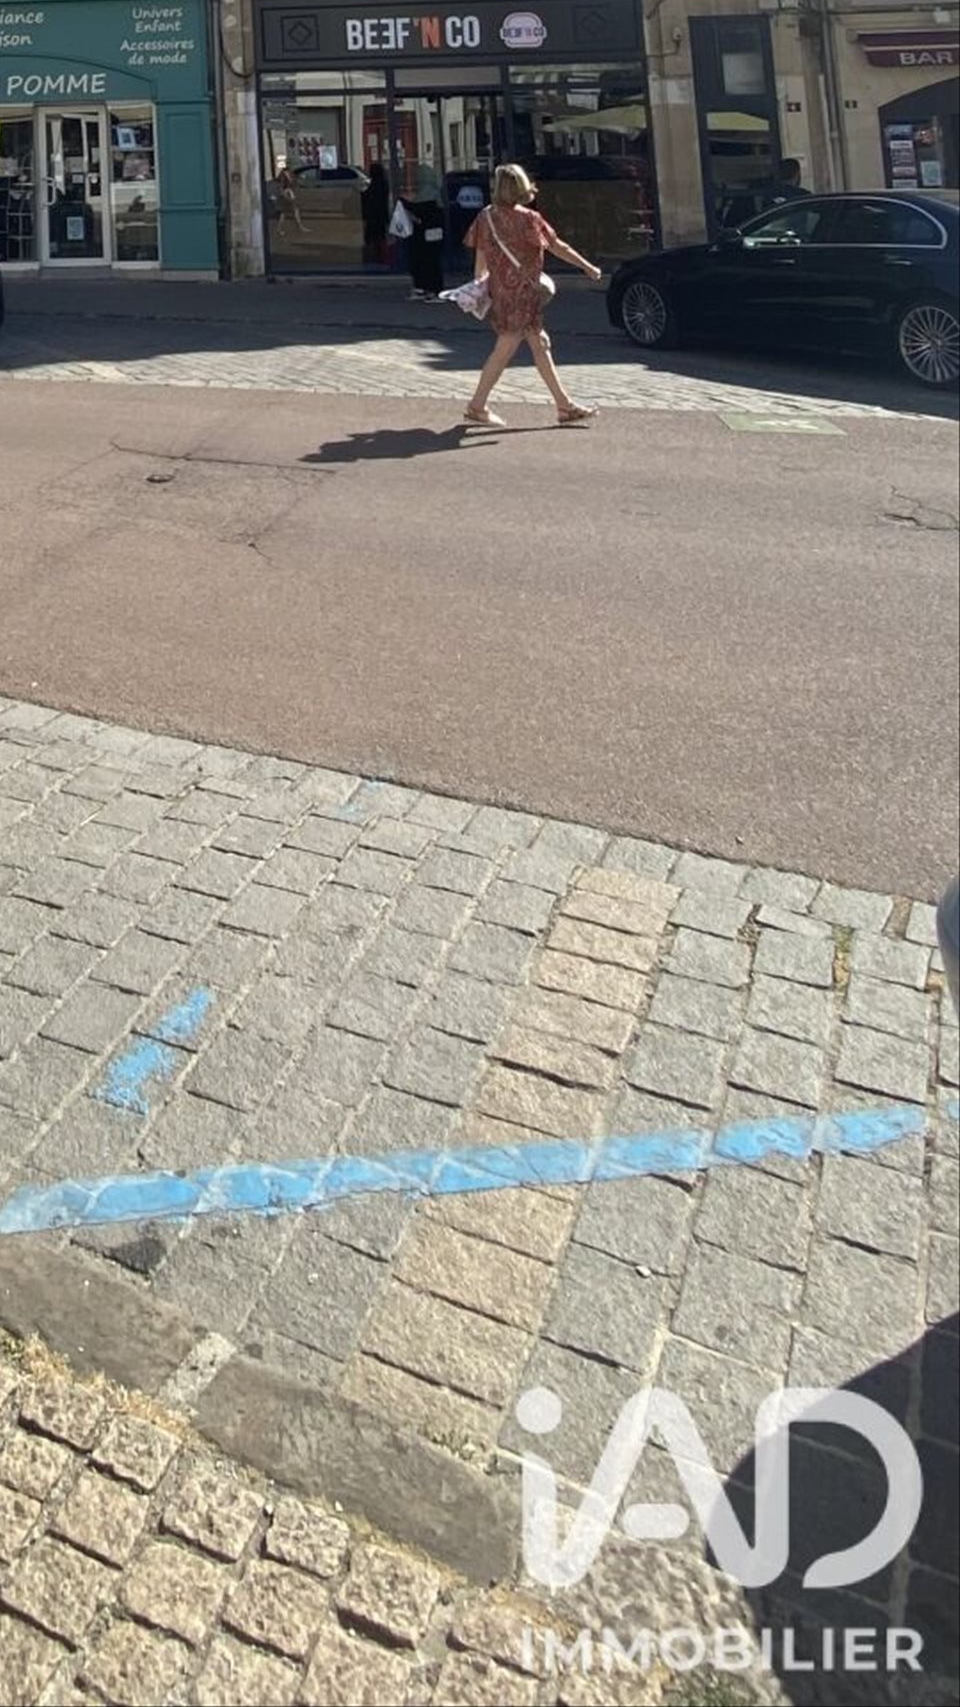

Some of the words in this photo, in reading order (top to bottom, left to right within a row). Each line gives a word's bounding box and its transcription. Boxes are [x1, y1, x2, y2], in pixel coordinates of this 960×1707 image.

[132, 6, 183, 19] Univers
[135, 19, 181, 33] Enfant
[346, 17, 411, 51] BEEF
[444, 15, 480, 48] CO
[120, 39, 194, 51] Accessoires
[128, 52, 144, 65] de
[149, 51, 187, 64] mode
[899, 51, 953, 65] BAR
[7, 73, 107, 95] POMME
